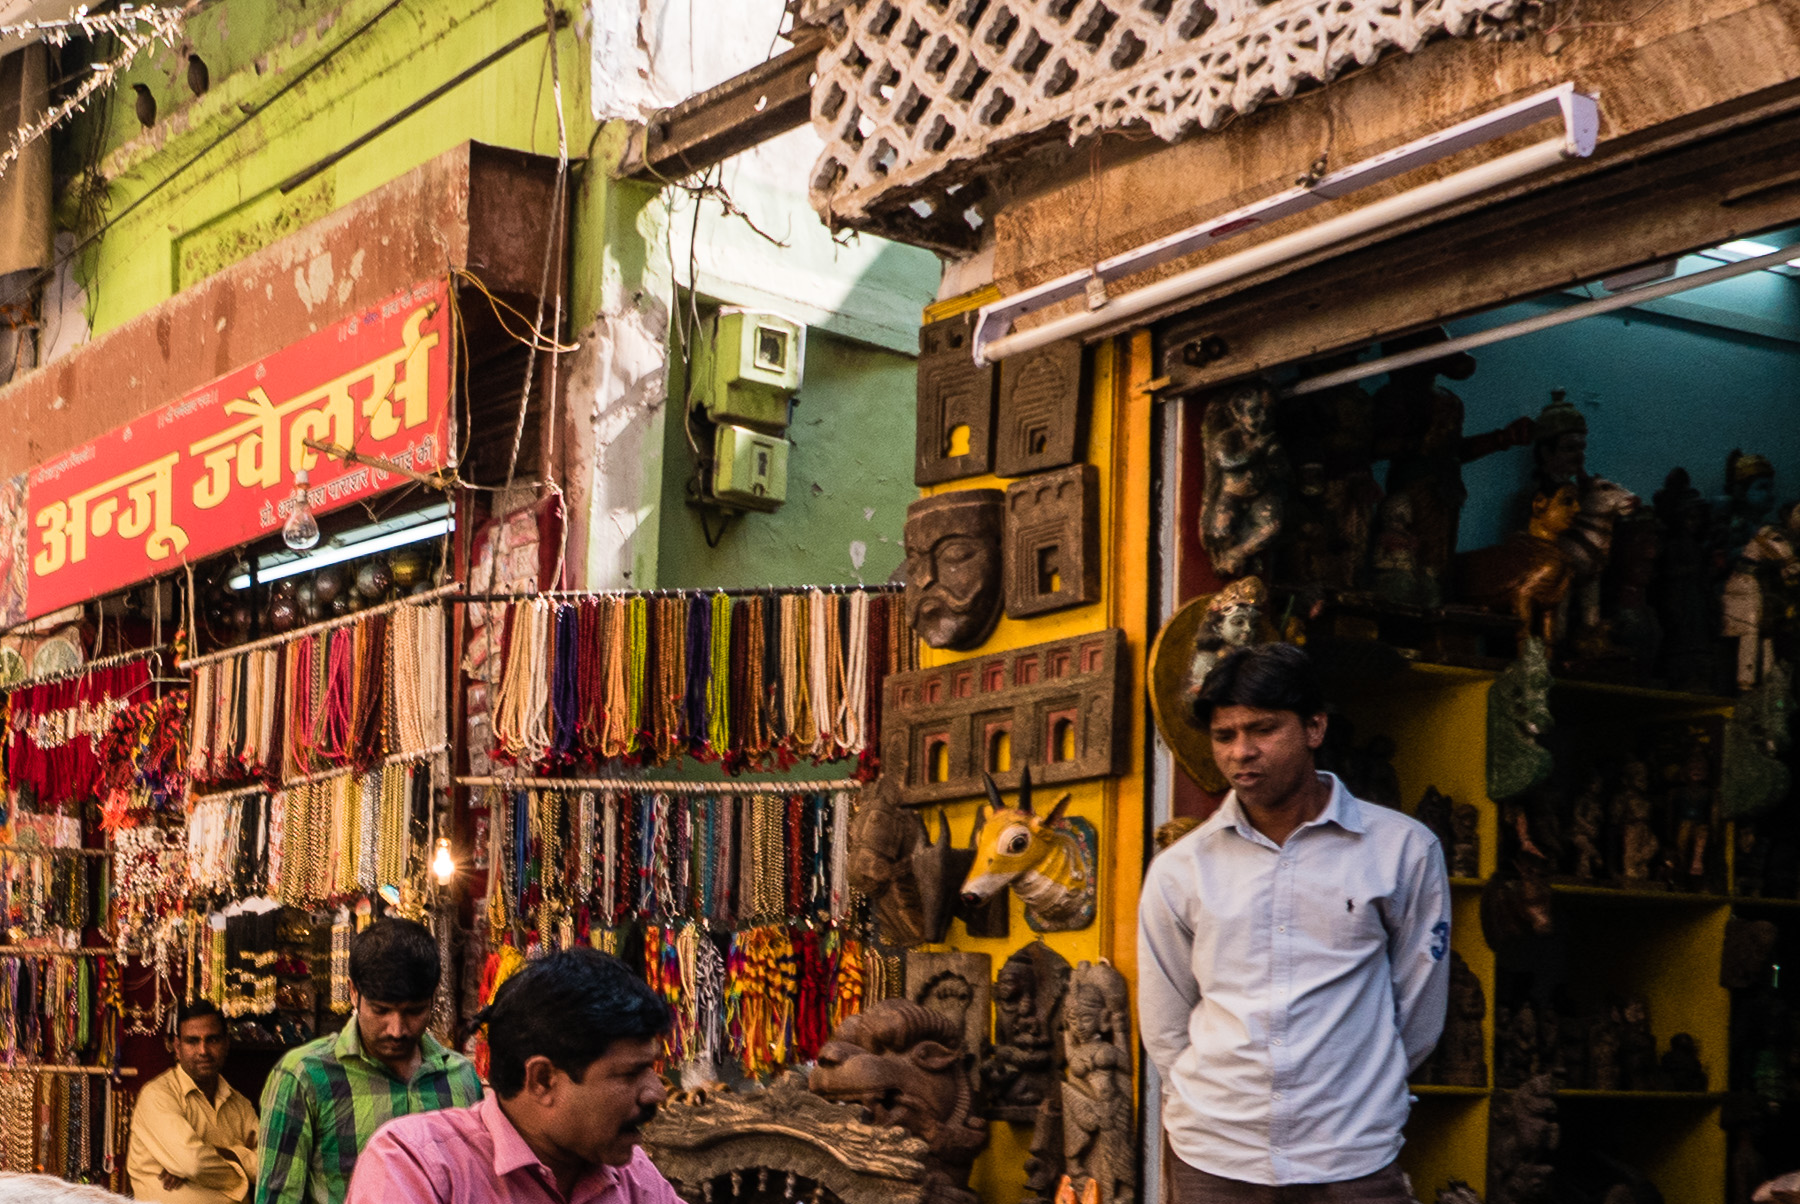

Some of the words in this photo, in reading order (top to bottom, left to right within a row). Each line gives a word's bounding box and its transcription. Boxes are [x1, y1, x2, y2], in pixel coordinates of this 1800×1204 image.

[33, 447, 190, 577] अन्जू
[189, 300, 440, 511] ज्वैलर्स
[1430, 921, 1450, 961] 3
